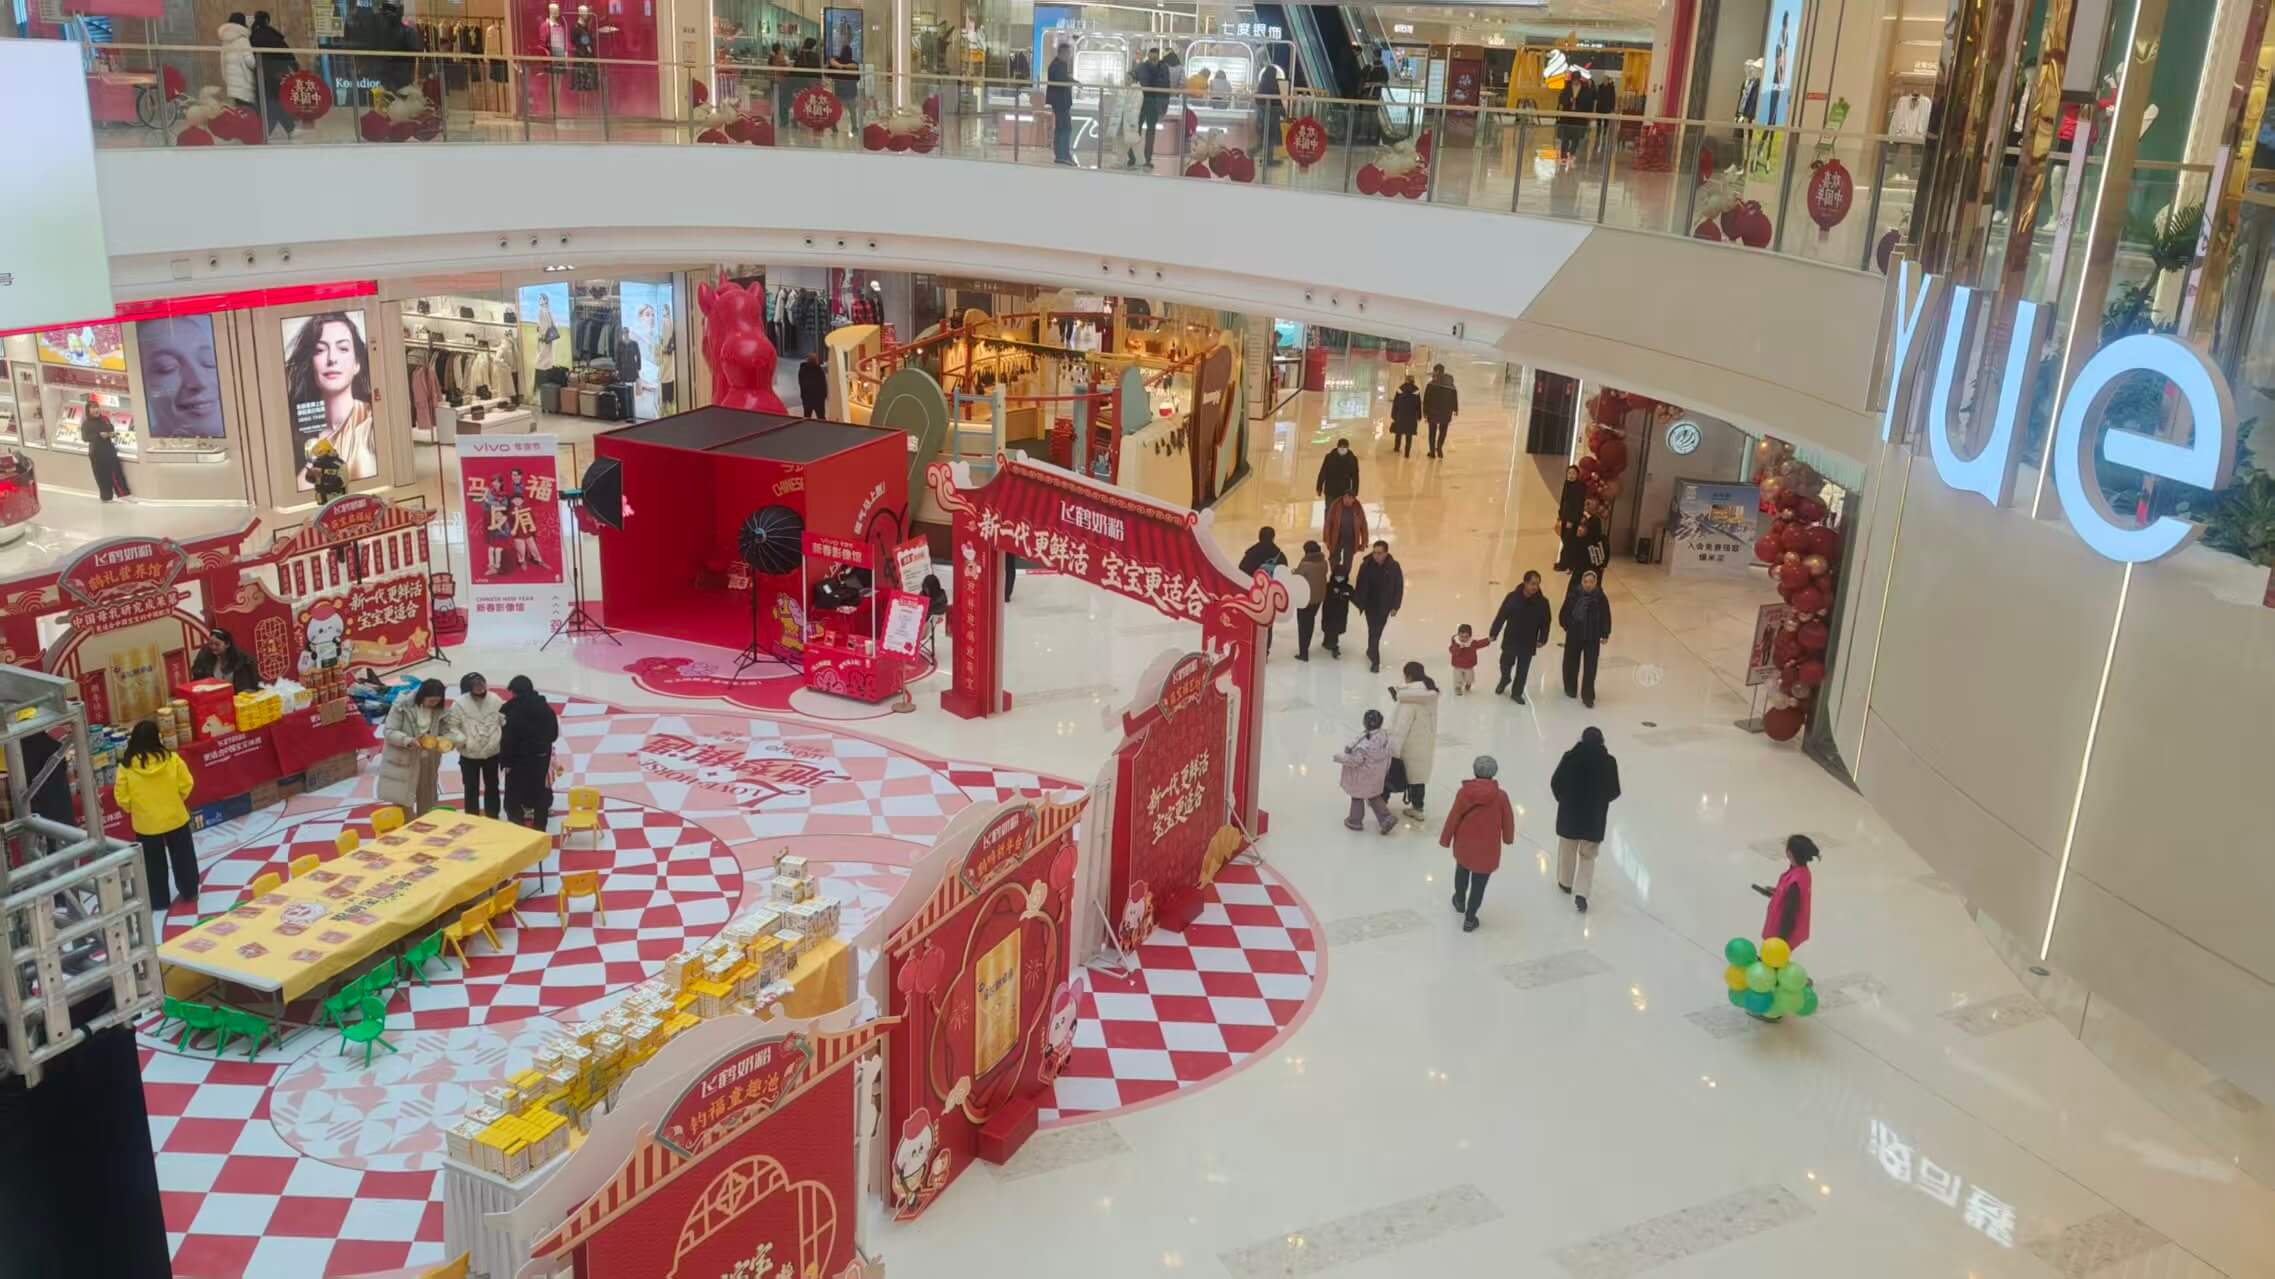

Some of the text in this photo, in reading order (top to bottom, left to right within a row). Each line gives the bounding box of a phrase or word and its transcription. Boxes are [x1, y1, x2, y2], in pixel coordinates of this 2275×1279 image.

[1220, 21, 1283, 40] 七度银饰
[473, 442, 511, 452] vivo
[1060, 500, 1125, 542] 飞鹤奶粉
[978, 507, 1211, 617] 新一代更鲜活 宝宝更适合
[350, 579, 423, 611] 新一代更鲜活
[357, 601, 420, 631] 宝宝更适合
[1147, 750, 1210, 817] 新一代更鲜活
[1152, 783, 1207, 846] 宝宝更适合
[700, 1047, 772, 1099] 飞鹤奶粉
